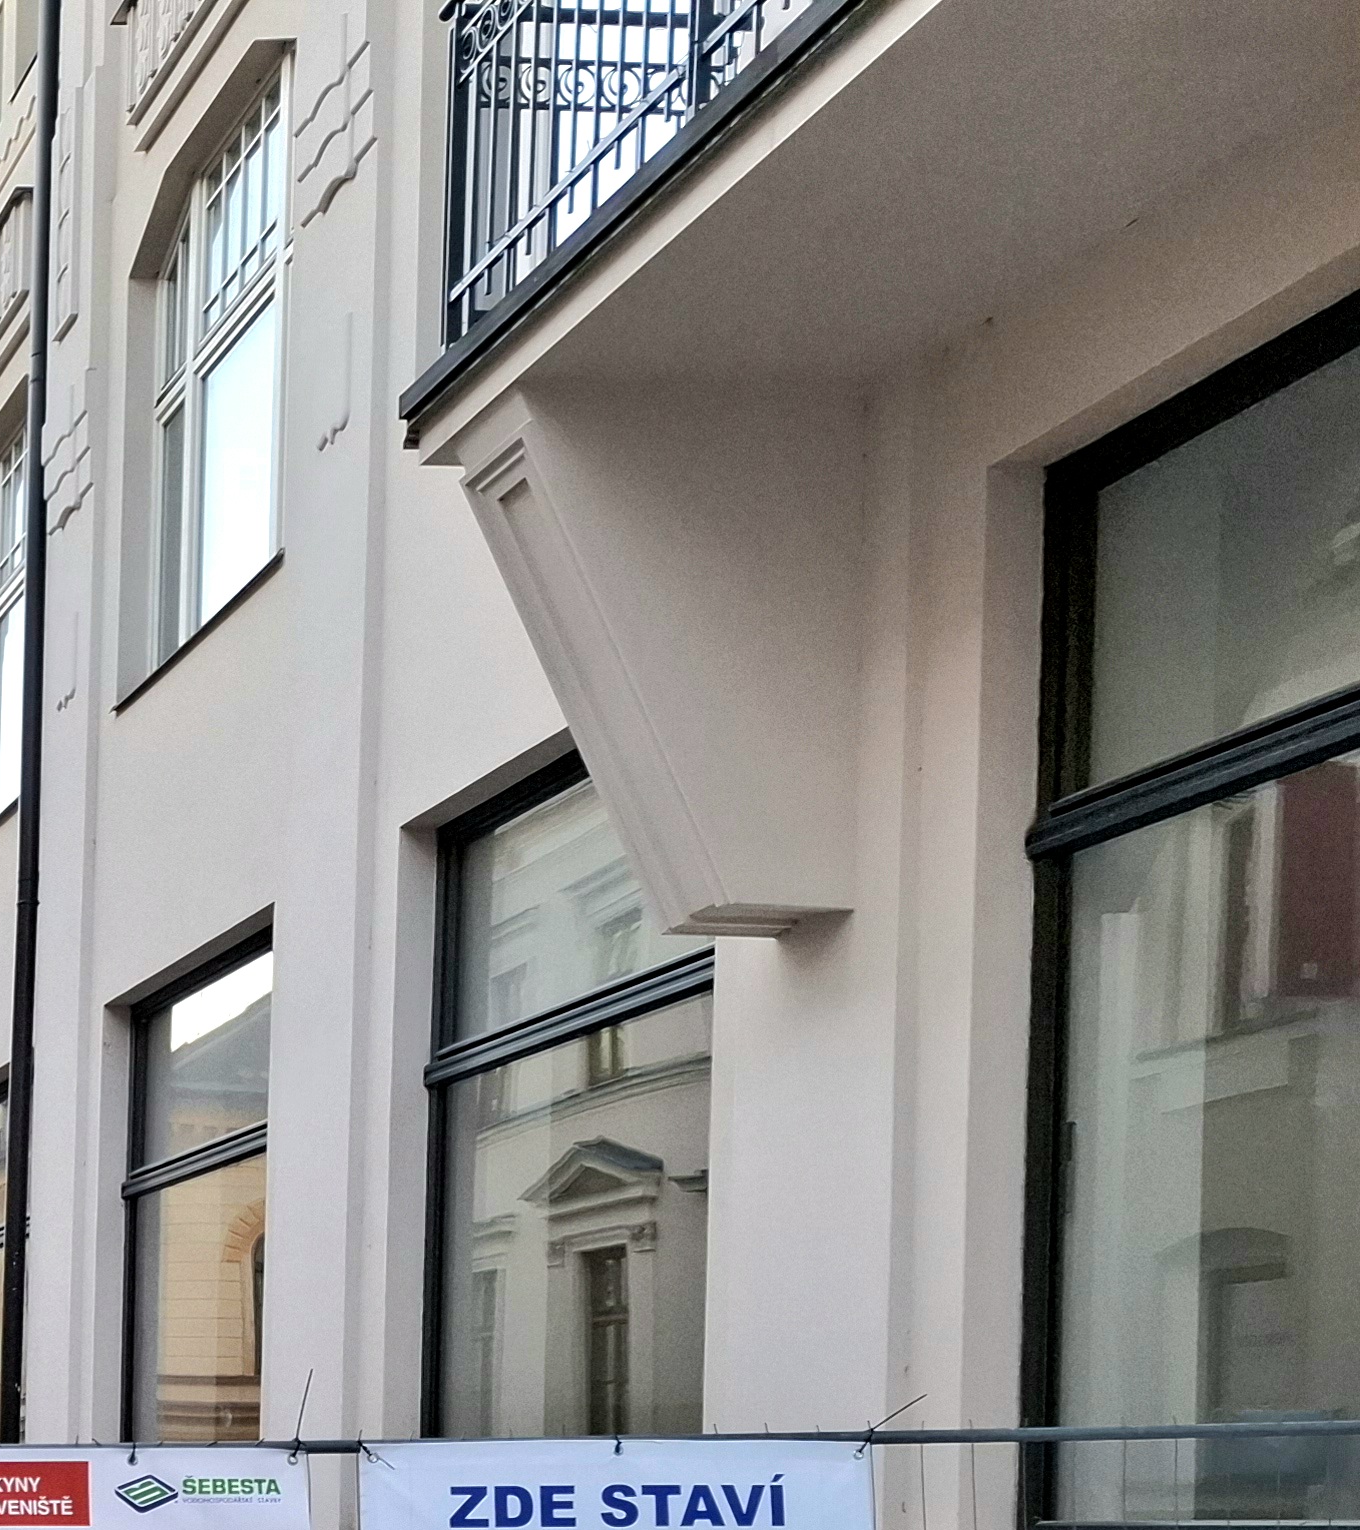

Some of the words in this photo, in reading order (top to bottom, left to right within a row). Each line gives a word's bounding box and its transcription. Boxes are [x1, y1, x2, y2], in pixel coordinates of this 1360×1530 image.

[182, 1475, 281, 1495] ŠEBESTA
[449, 1484, 578, 1530] ZDE
[599, 1473, 786, 1528] STAVÍ
